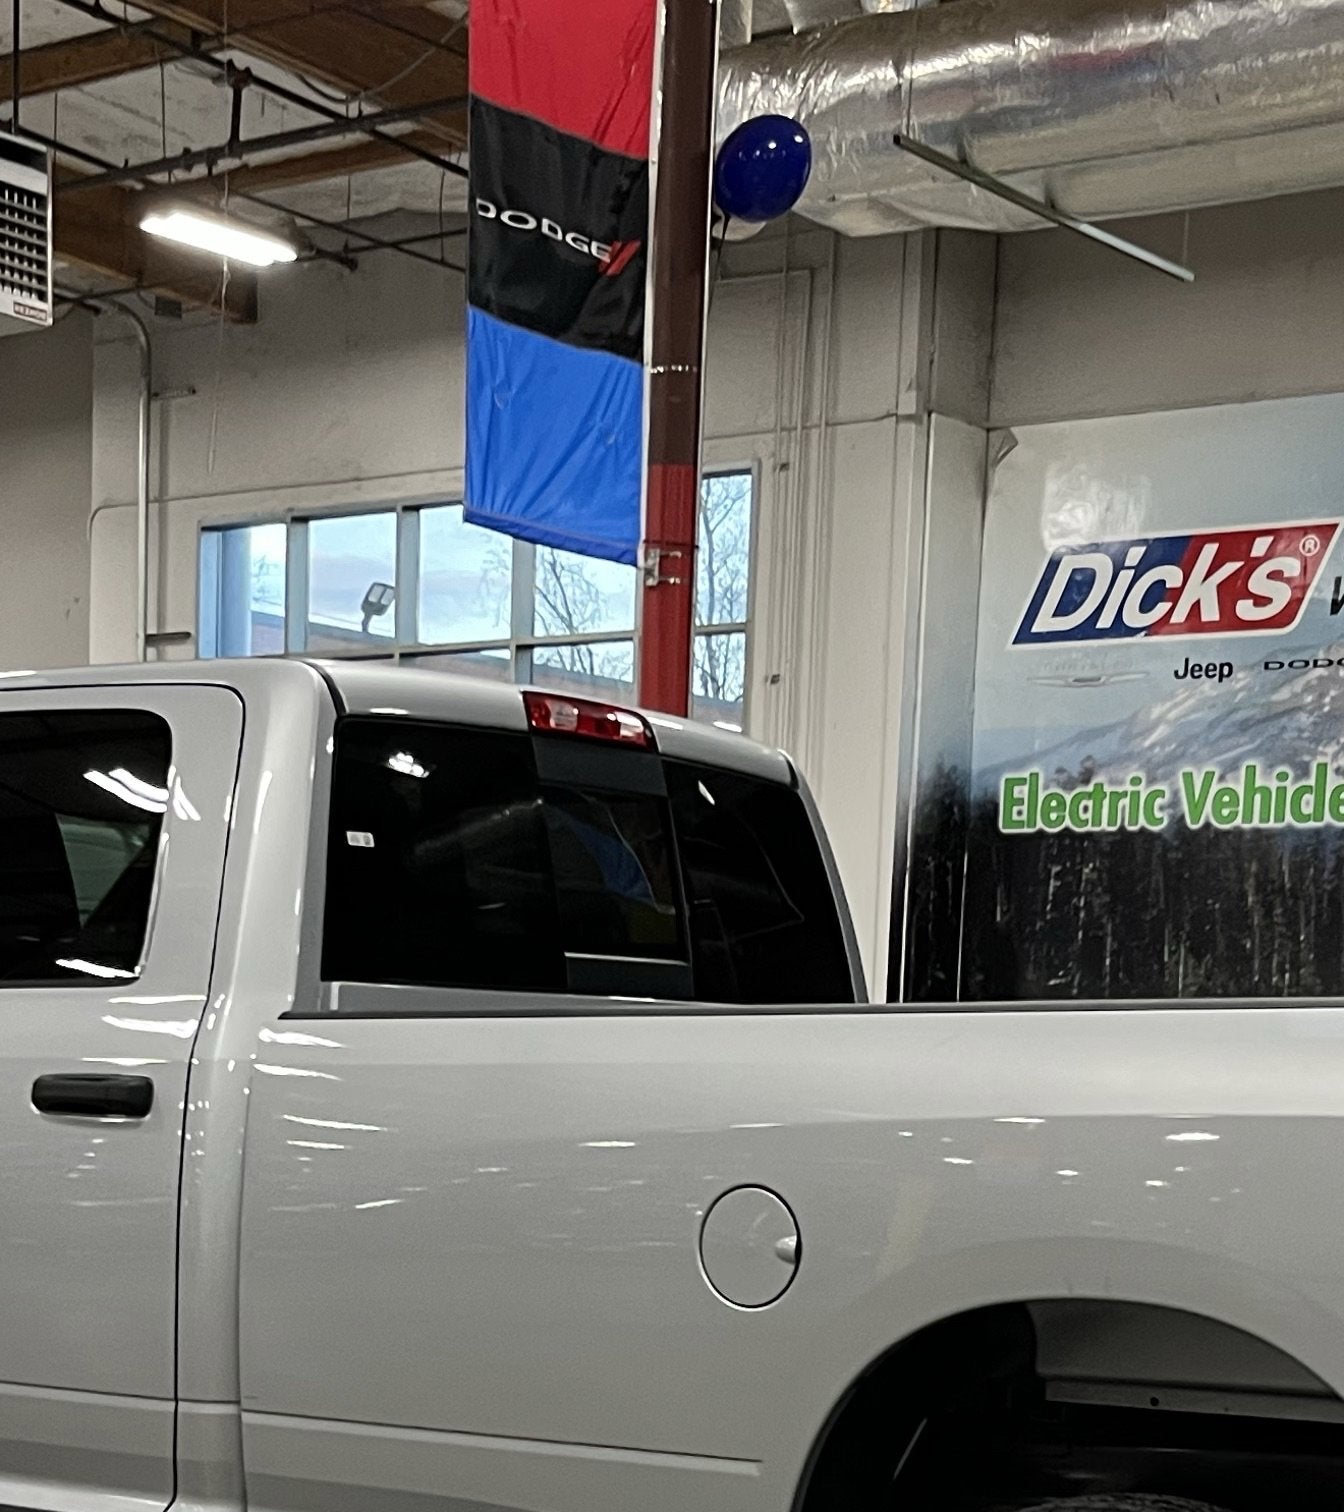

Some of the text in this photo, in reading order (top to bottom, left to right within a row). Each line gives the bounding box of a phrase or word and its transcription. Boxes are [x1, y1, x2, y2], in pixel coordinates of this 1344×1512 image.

[475, 197, 613, 263] DODGE
[1029, 535, 1302, 633] Dick's
[1173, 656, 1234, 683] Jeep
[999, 772, 1167, 830] Electric
